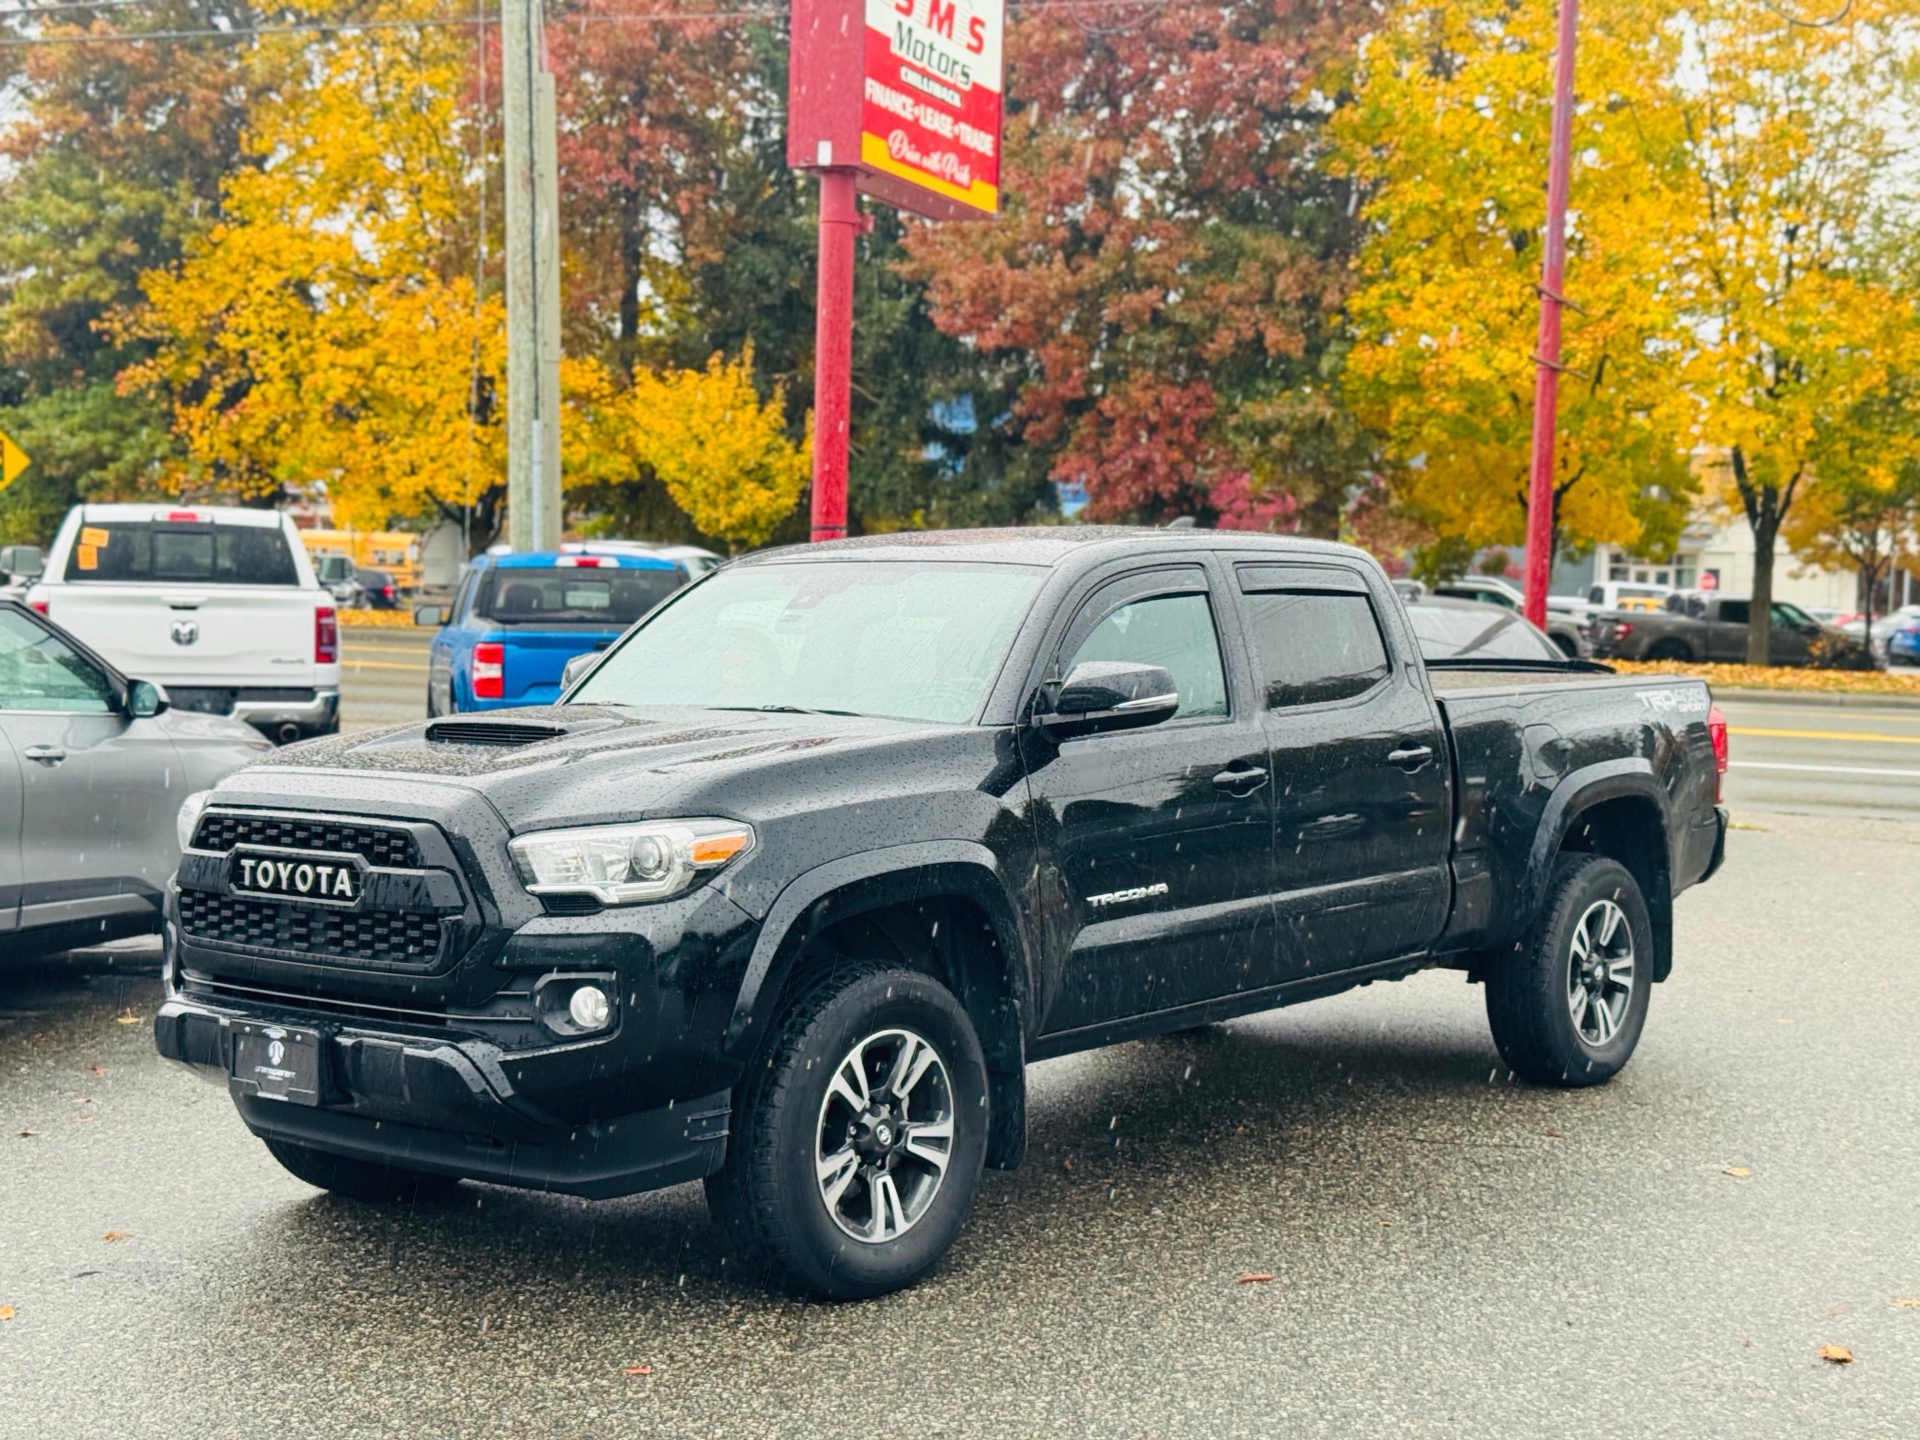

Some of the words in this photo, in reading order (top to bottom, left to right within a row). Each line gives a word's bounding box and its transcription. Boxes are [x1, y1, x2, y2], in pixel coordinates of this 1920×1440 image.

[892, 20, 971, 86] Motors
[865, 77, 915, 122] FINANCE
[919, 103, 954, 139] LEASE
[959, 121, 994, 157] TRADE
[240, 859, 353, 897] TOYOTA
[1086, 882, 1169, 907] TACOMA
